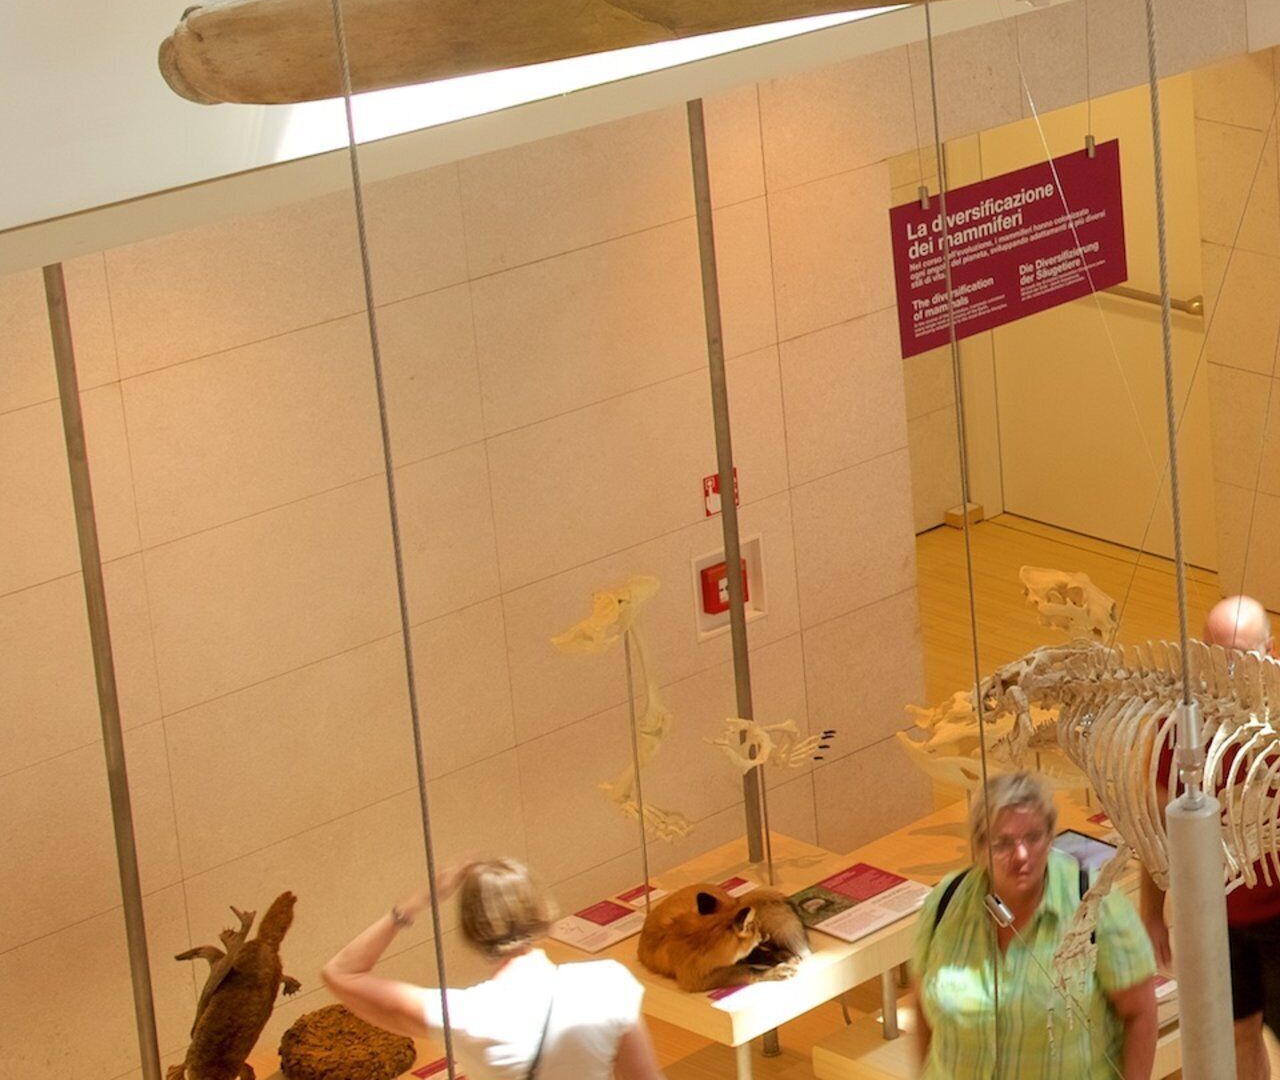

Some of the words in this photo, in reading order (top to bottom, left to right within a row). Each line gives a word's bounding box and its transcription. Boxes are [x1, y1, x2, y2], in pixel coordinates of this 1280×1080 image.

[906, 223, 928, 241] La
[931, 182, 1055, 233] dversificazione
[908, 236, 934, 260] dei
[909, 268, 926, 281] ogni
[951, 257, 962, 268] del
[962, 250, 989, 265] pianeta,
[990, 235, 1029, 255] sviluppando
[1029, 222, 1067, 242] adattamenti
[1085, 208, 1106, 223] diversi
[909, 261, 922, 272] Nel
[922, 256, 943, 268] corso
[998, 226, 1033, 244] mammiferi
[1033, 219, 1054, 233] hanno
[1018, 262, 1035, 276] Die
[924, 275, 932, 285] di
[1020, 274, 1035, 286] der
[912, 298, 931, 311] The
[913, 309, 924, 321] of
